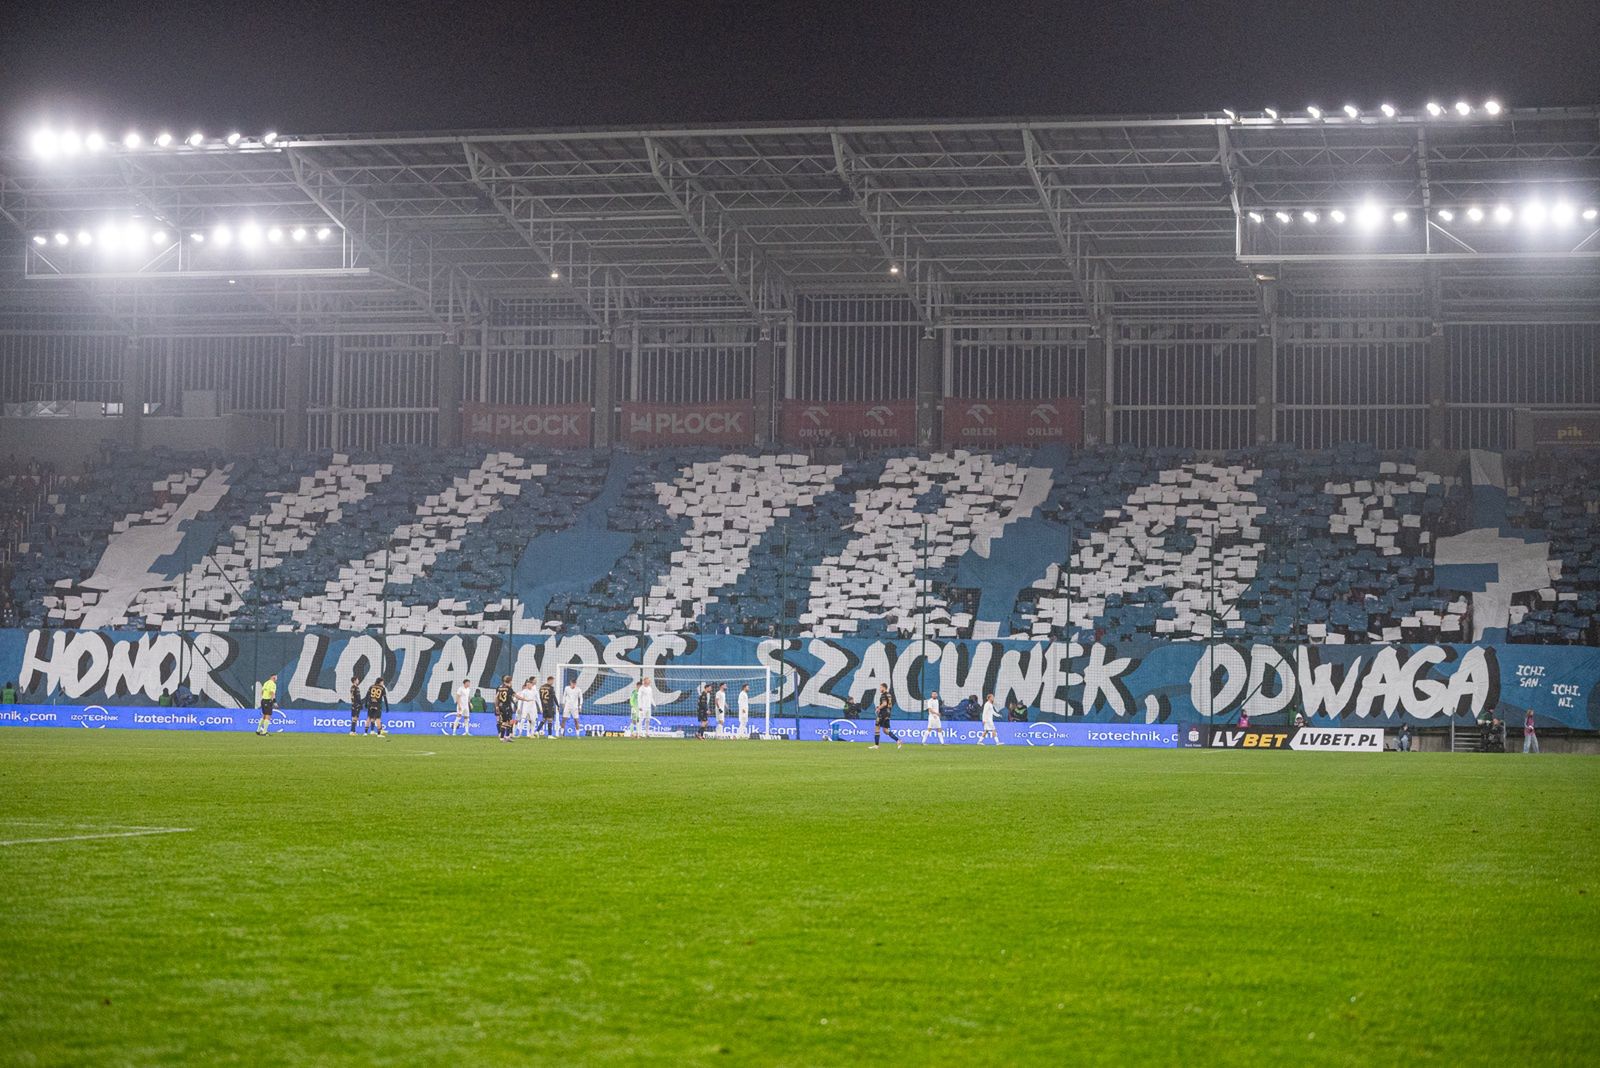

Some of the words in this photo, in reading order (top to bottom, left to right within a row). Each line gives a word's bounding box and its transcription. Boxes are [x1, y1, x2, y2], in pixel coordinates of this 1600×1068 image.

[656, 412, 743, 433] PŁOCK
[863, 428, 898, 437] ORLEN
[961, 427, 997, 436] ORLEN
[1027, 427, 1063, 436] ORLEN
[1189, 643, 1491, 720] ODWAGA
[370, 688, 382, 699] 99
[134, 713, 233, 726] izotechnik.com
[1300, 733, 1377, 746] LVBET.PL
